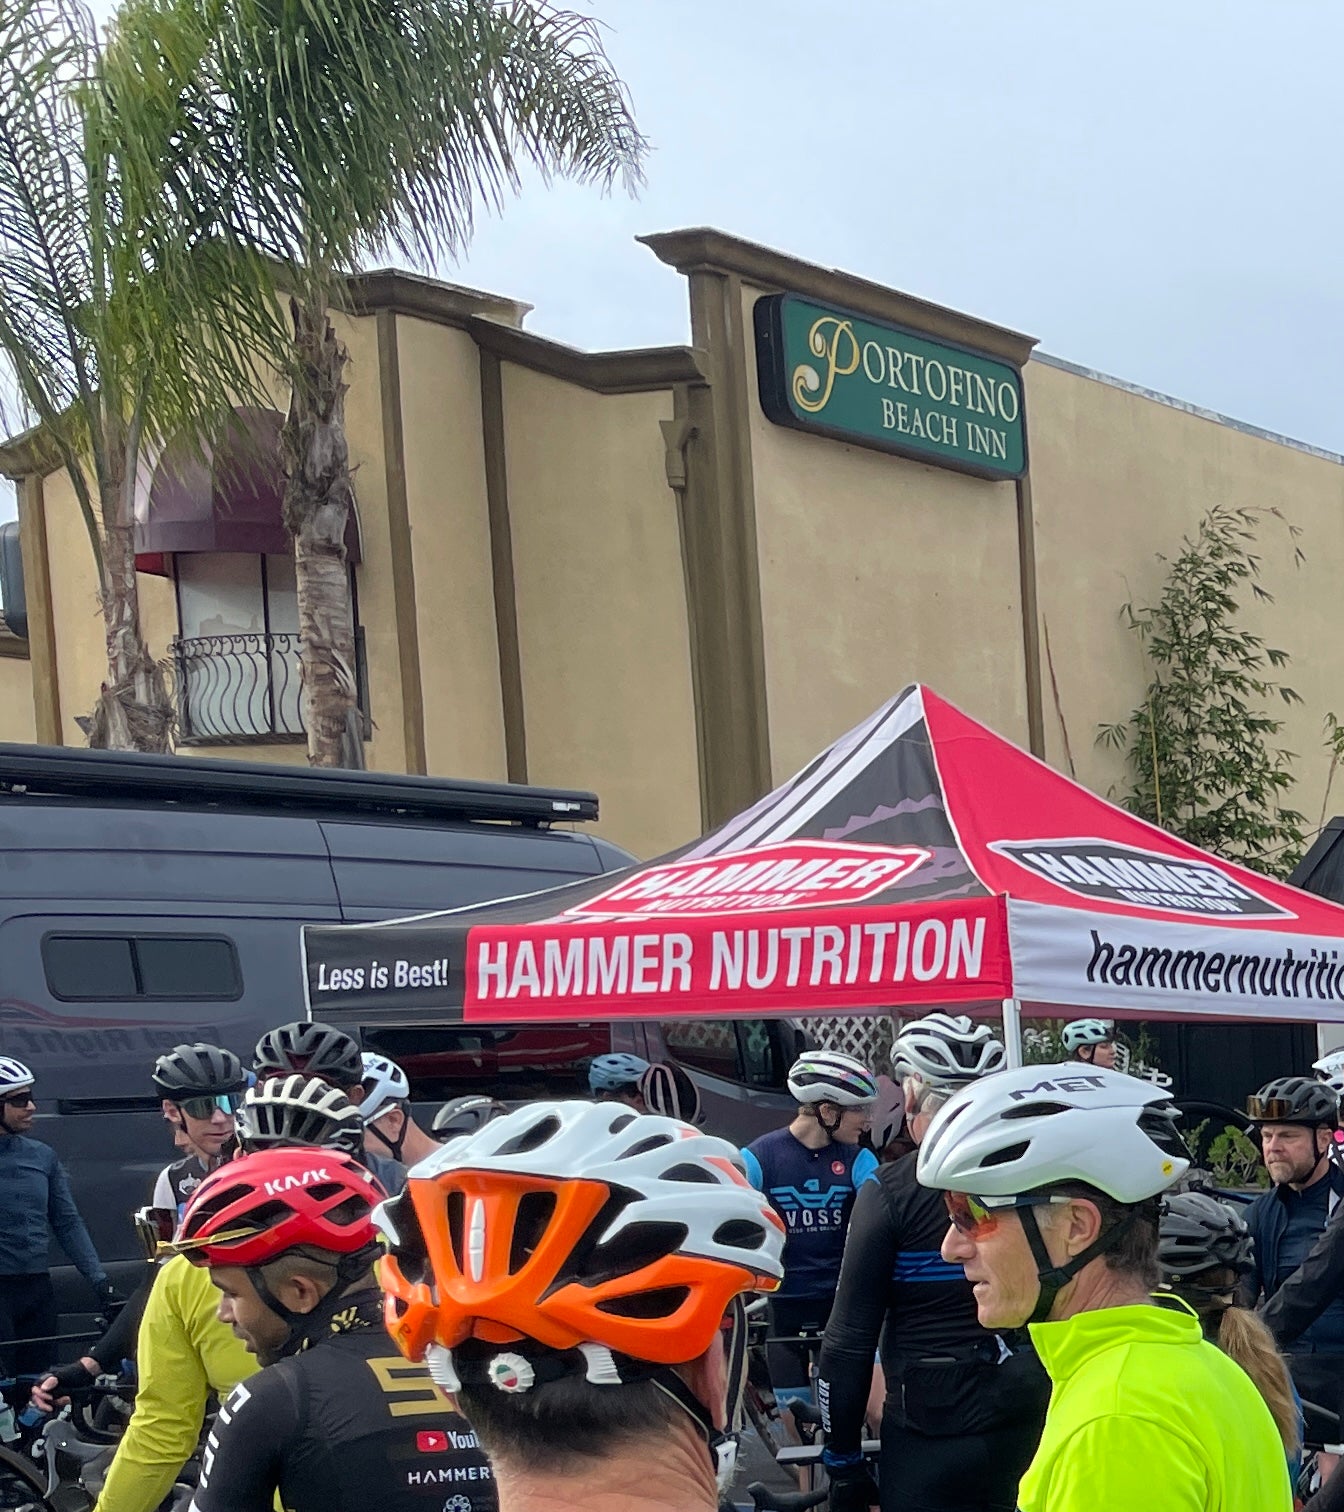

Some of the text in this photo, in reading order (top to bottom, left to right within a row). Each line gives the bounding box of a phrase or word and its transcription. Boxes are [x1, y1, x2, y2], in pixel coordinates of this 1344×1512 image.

[793, 317, 1018, 422] PORTOFINO
[882, 398, 1007, 459] BEACH INN
[623, 851, 892, 900] HAMMER
[1022, 852, 1251, 901] HAMMER
[641, 891, 809, 912] NUTRITION
[1116, 888, 1241, 912] NUTRITION
[477, 917, 986, 1000] HAMMER NUTRITION
[317, 959, 449, 992] Less is Best!
[1009, 1075, 1106, 1101] MET
[263, 1168, 332, 1196] KASK
[786, 1208, 842, 1228] VOSS
